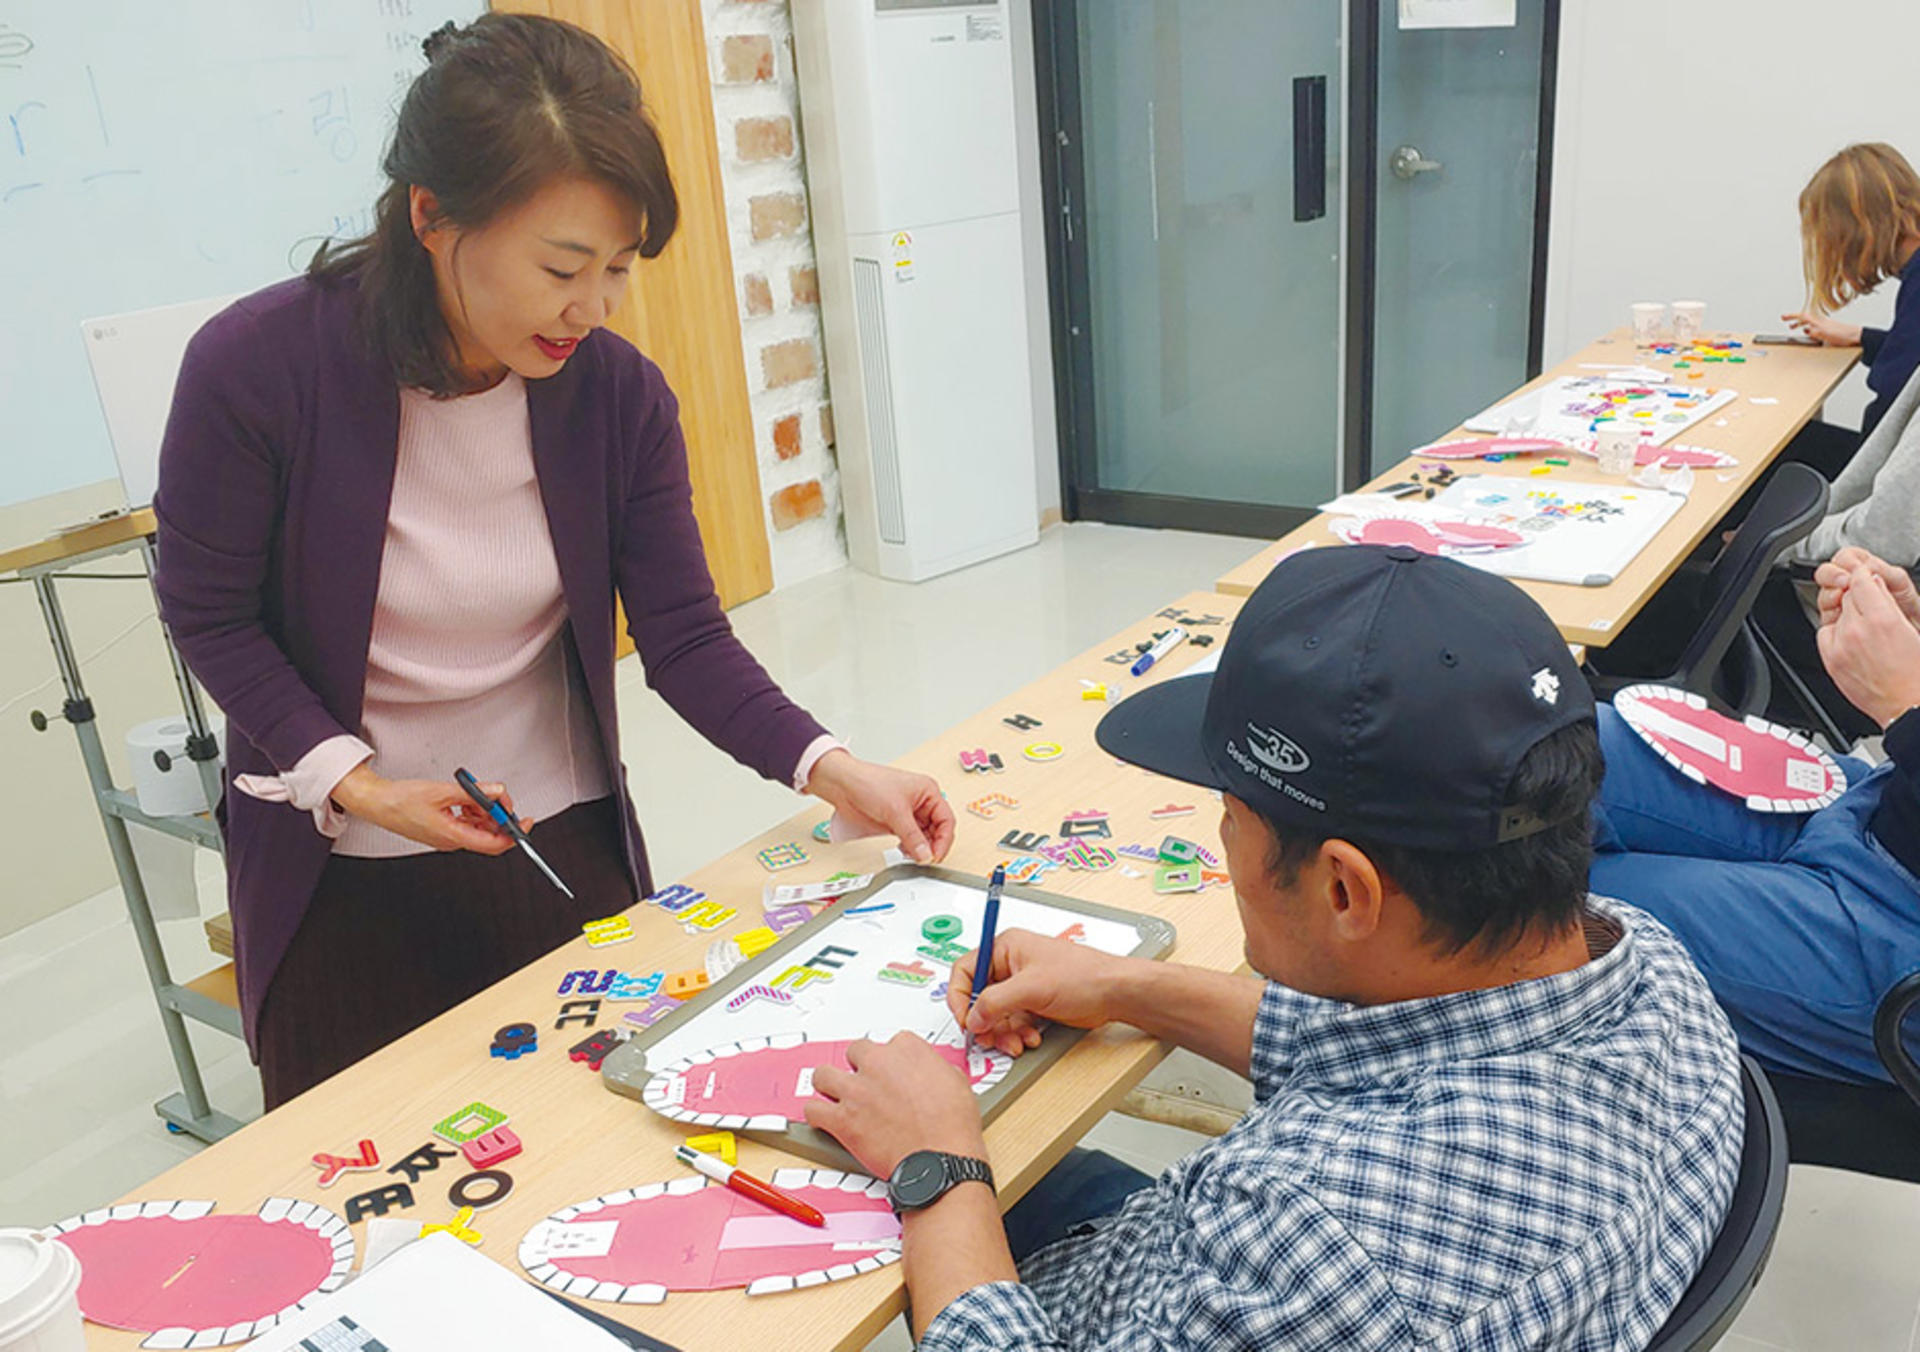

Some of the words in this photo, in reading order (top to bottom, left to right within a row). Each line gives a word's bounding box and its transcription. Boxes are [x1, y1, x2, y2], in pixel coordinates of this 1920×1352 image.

[1226, 740, 1260, 775] Design
[1259, 766, 1283, 791] that
[1283, 783, 1326, 812] moves
[1266, 735, 1294, 767] 35
